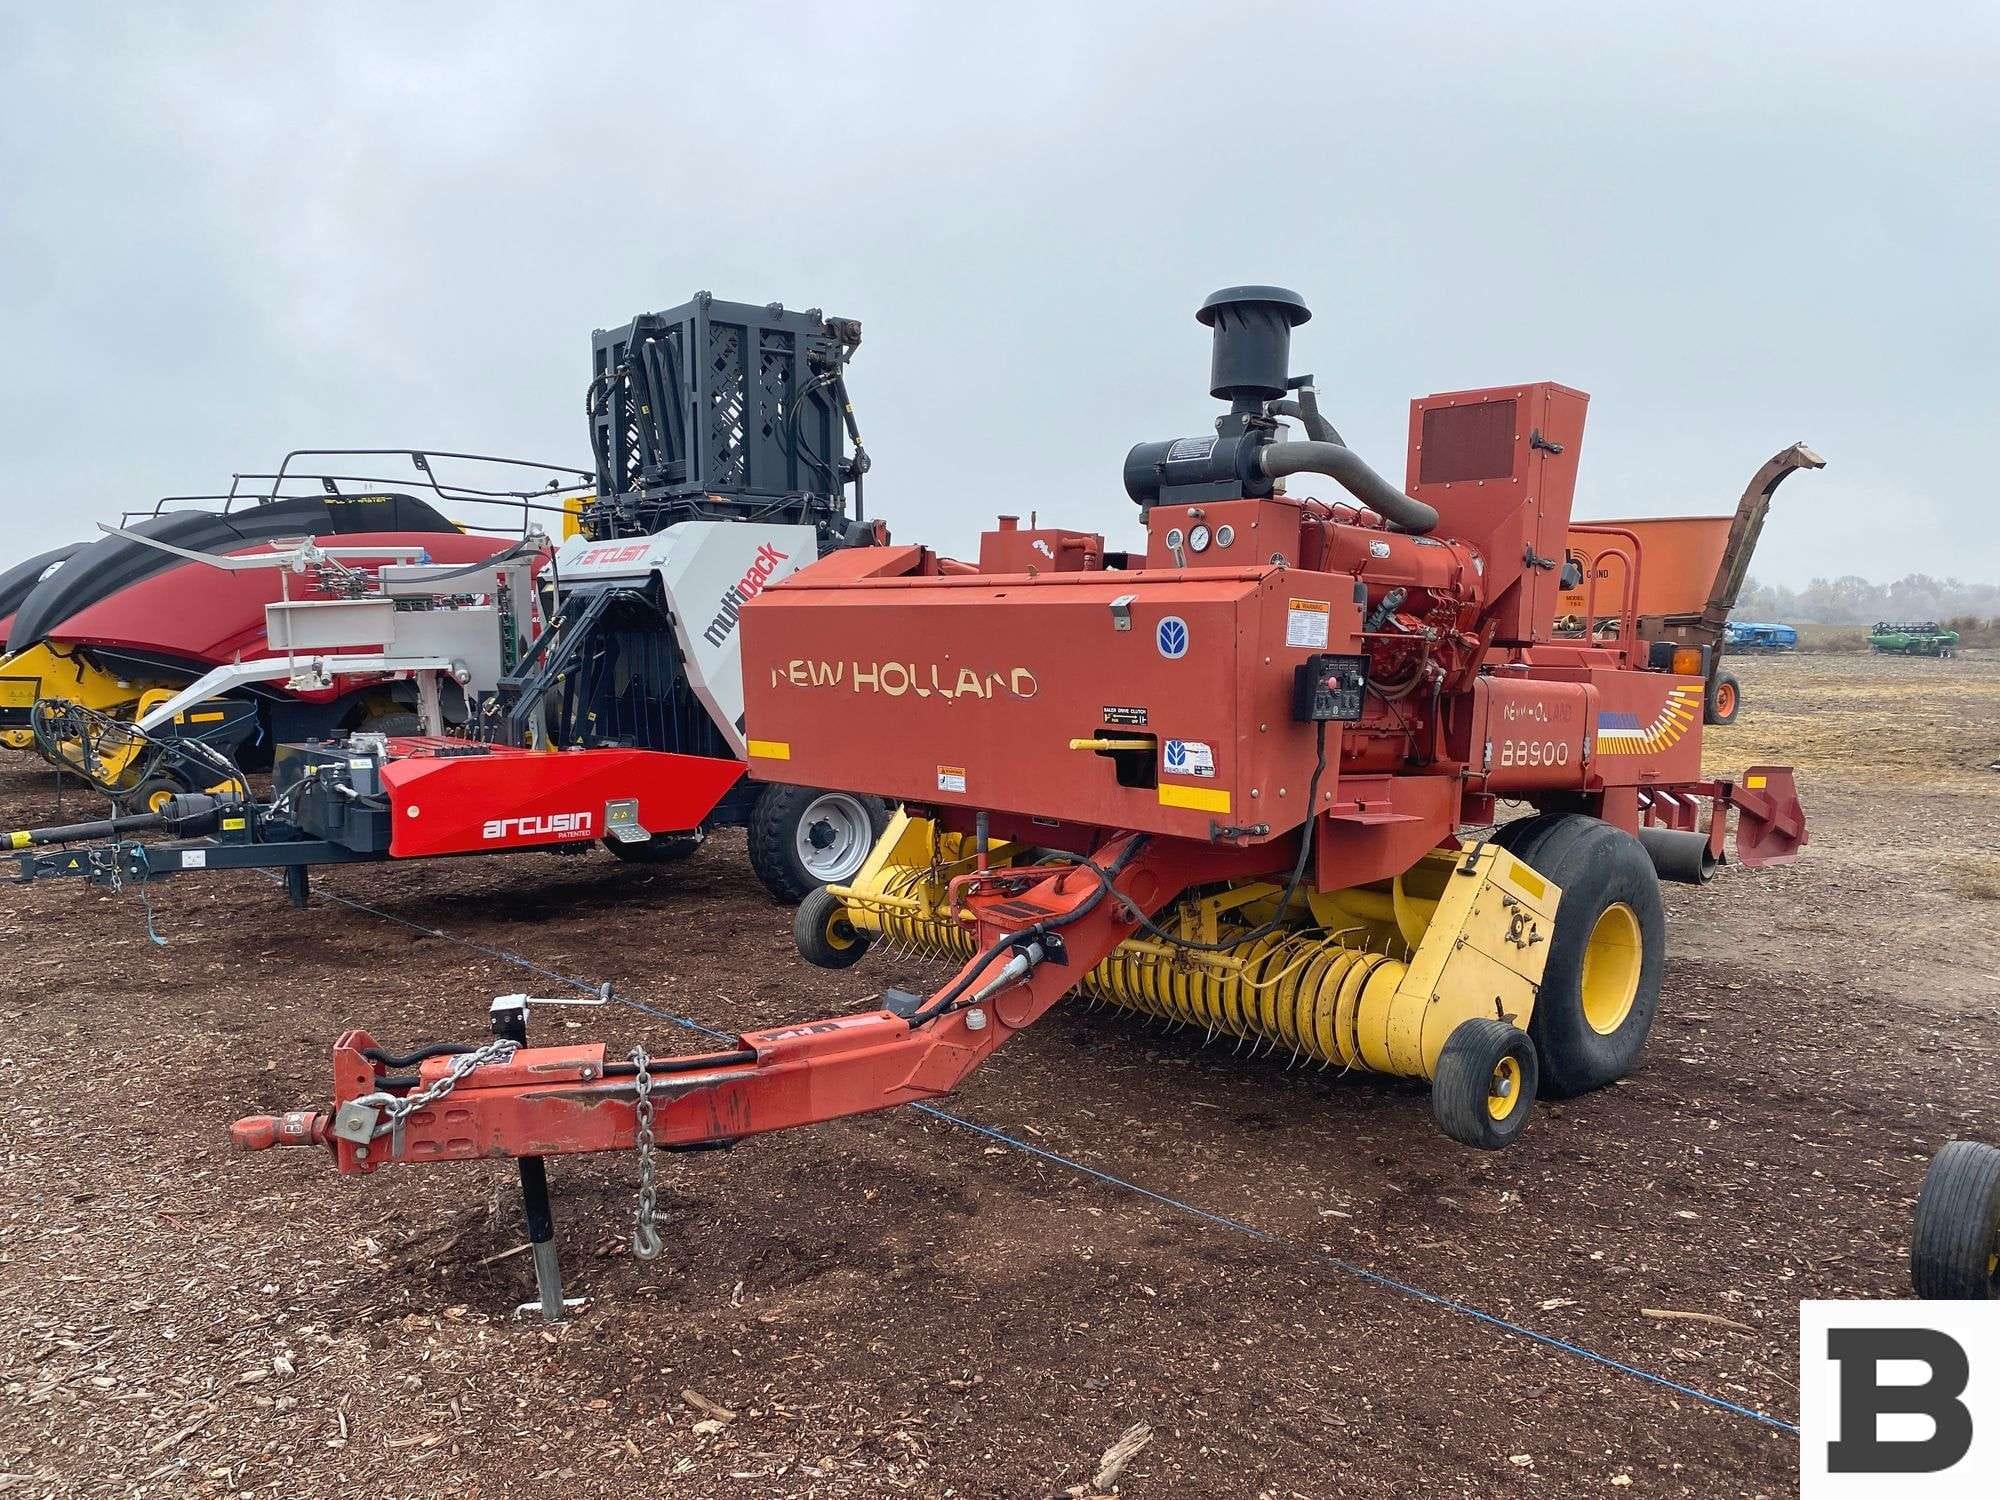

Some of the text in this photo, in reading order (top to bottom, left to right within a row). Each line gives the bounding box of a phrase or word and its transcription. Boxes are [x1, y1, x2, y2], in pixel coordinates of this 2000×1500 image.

[1586, 569, 1609, 579] GIND
[703, 541, 790, 649] multipack
[852, 661, 1038, 699] HOLLAND
[482, 811, 592, 839] arcusin
[558, 829, 591, 839] PATENTED
